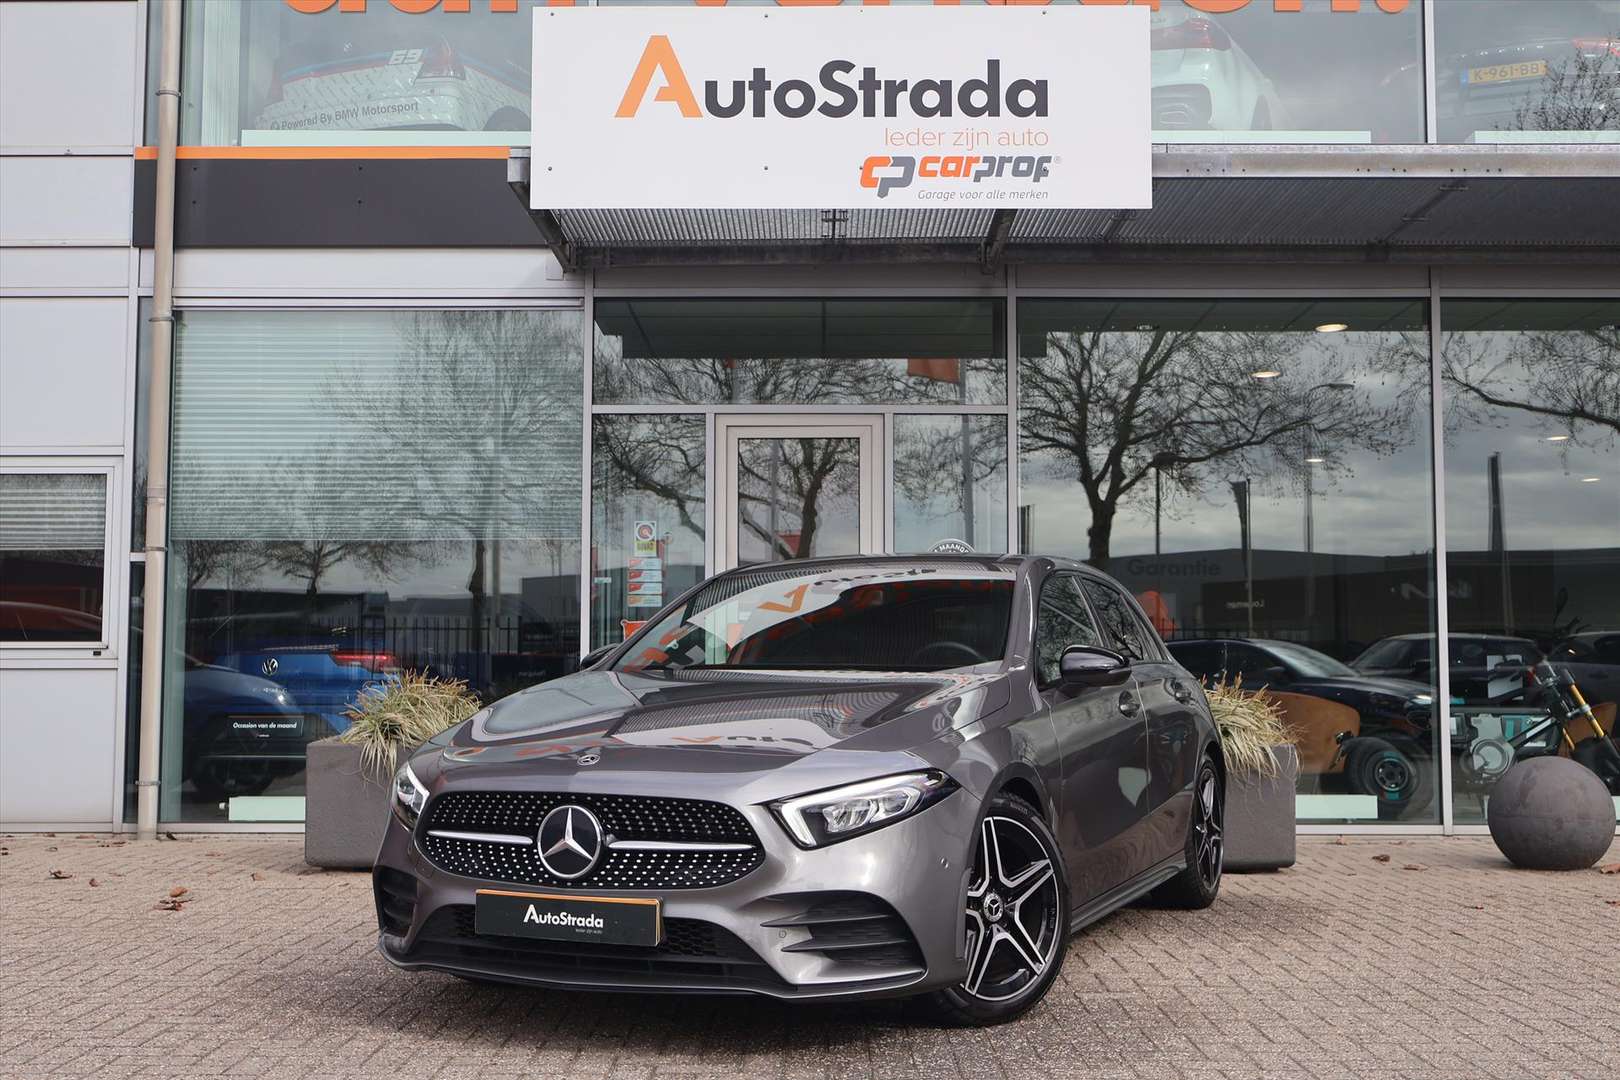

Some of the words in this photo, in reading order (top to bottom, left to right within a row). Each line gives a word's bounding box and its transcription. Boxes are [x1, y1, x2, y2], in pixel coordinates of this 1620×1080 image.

[389, 49, 424, 65] 69
[614, 35, 1048, 118] AutoStrada
[281, 114, 318, 130] Powered
[320, 112, 332, 124] By
[335, 107, 359, 121] BMW
[362, 102, 419, 117] Motorsport
[884, 128, 945, 146] Ieder
[952, 128, 990, 150] zijn
[997, 130, 1049, 146] auto
[918, 189, 955, 201] Garage
[959, 190, 984, 200] voor
[986, 189, 1006, 200] alle
[1009, 189, 1049, 200] merken
[1127, 558, 1221, 576] Garantie
[232, 721, 257, 729] Occasion
[277, 721, 298, 729] maand
[523, 904, 604, 928] AutoStrada
